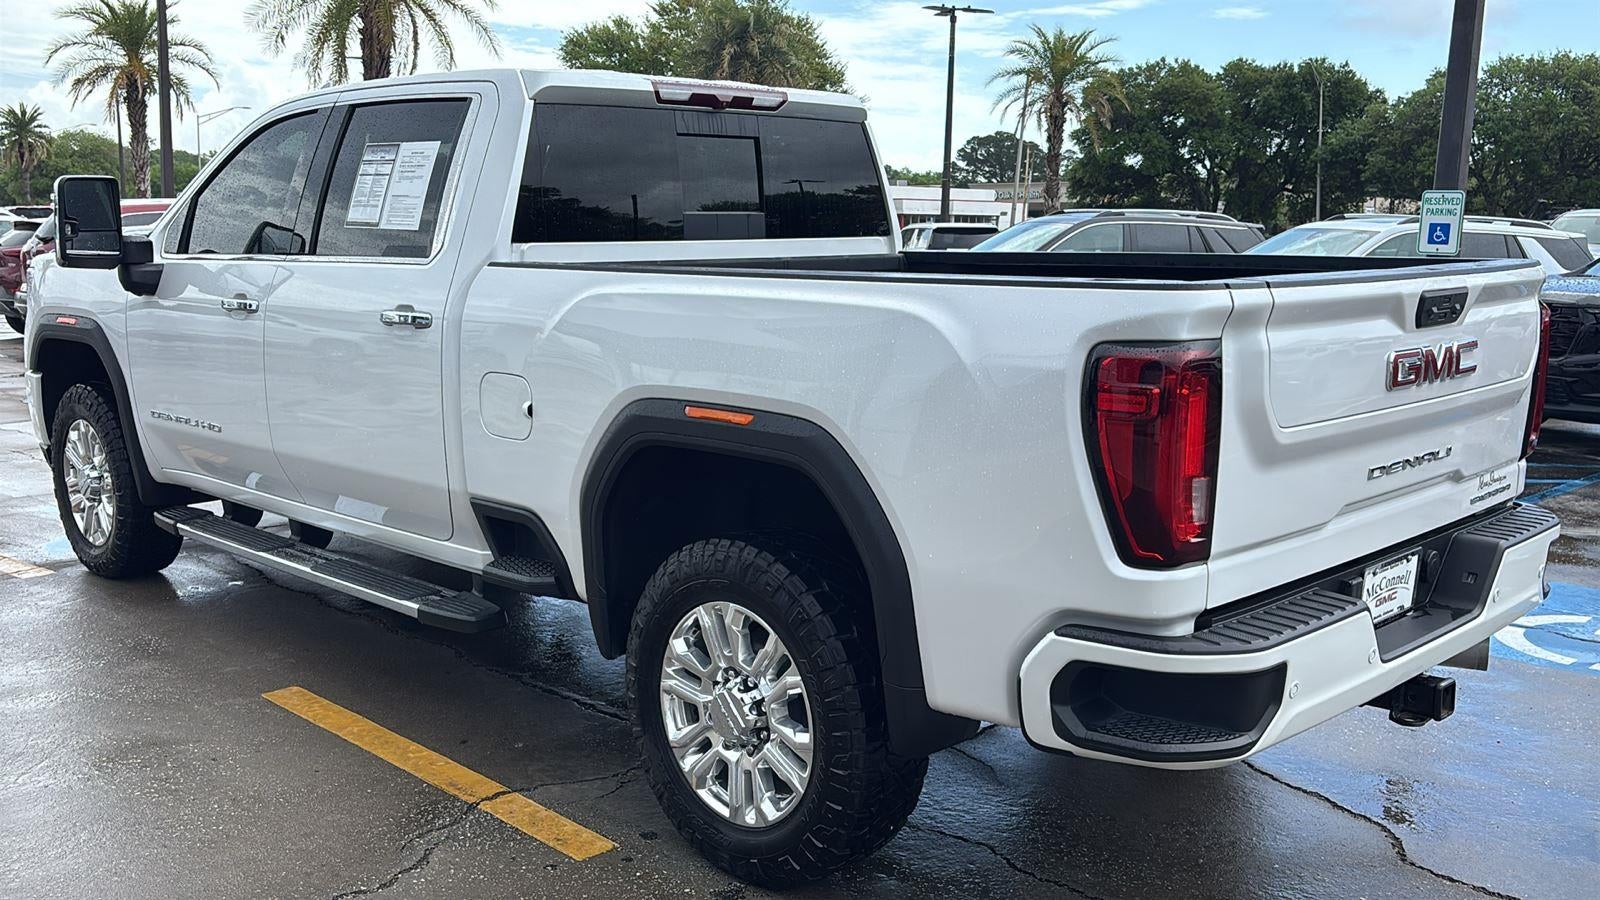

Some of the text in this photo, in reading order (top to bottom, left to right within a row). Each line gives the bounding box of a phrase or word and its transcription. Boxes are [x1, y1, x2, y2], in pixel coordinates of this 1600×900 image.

[1424, 197, 1461, 206] RESERVED
[1425, 208, 1458, 216] PARKING
[1386, 340, 1478, 391] GMC
[1367, 446, 1452, 481] DENALI
[1366, 570, 1411, 598] McConnell
[1375, 591, 1398, 607] GMC
